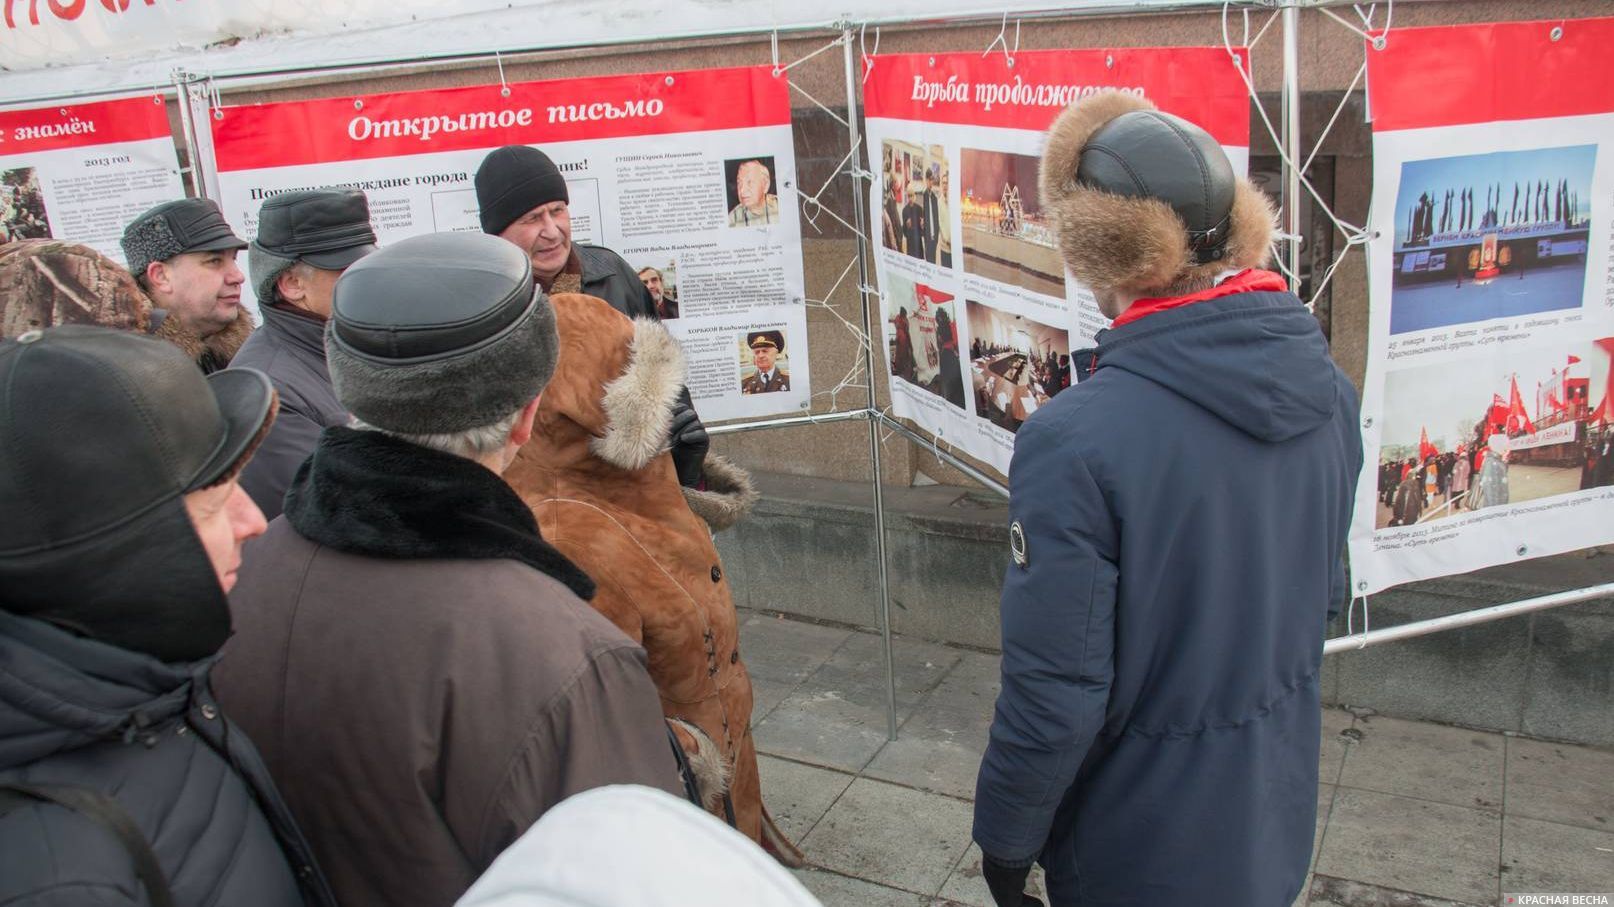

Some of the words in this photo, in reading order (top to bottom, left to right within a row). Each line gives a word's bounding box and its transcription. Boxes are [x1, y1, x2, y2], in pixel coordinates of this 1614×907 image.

[911, 75, 969, 107] Борьба
[14, 117, 96, 141] знамён
[348, 107, 532, 141] Открытое
[547, 99, 663, 123] письмо
[84, 157, 110, 168] 2013
[112, 155, 131, 165] год
[415, 172, 469, 187] города
